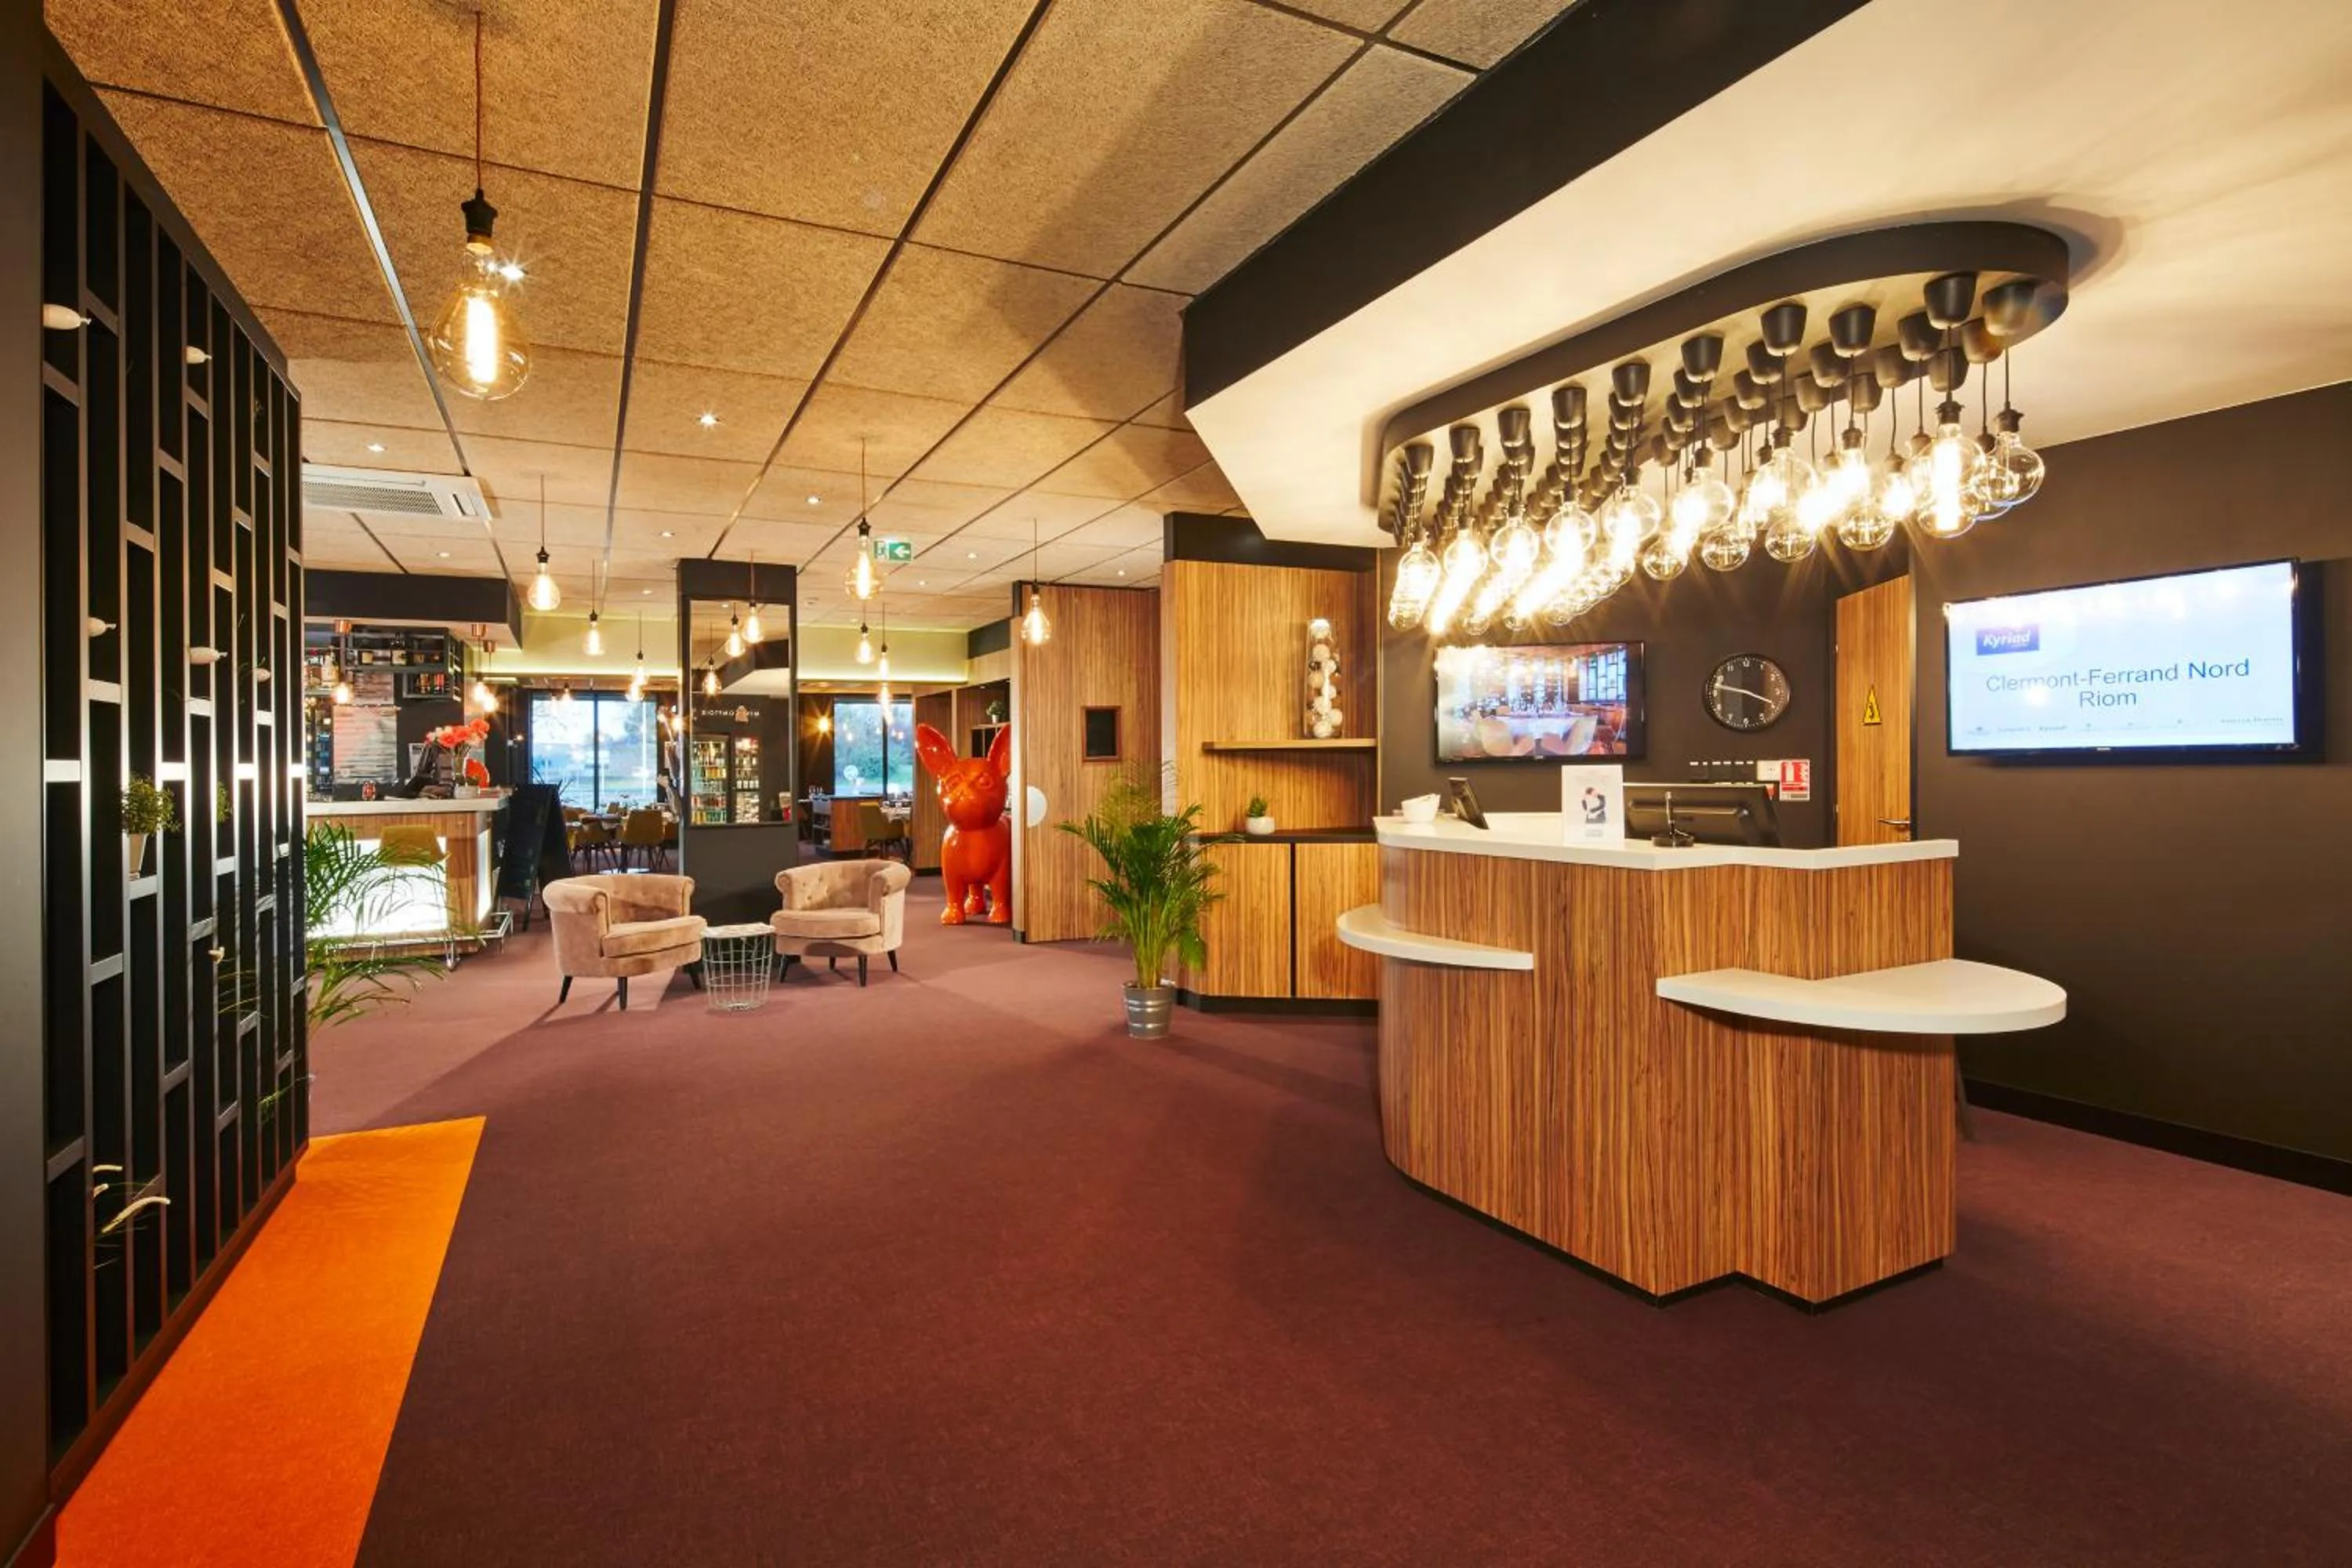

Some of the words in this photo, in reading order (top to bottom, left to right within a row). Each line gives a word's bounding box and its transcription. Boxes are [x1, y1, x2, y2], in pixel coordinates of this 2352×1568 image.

[1982, 628, 2031, 649] Kyriad
[1986, 664, 2179, 691] Clermont-Ferrand
[2188, 659, 2250, 679] Nord
[2079, 690, 2137, 707] Riom
